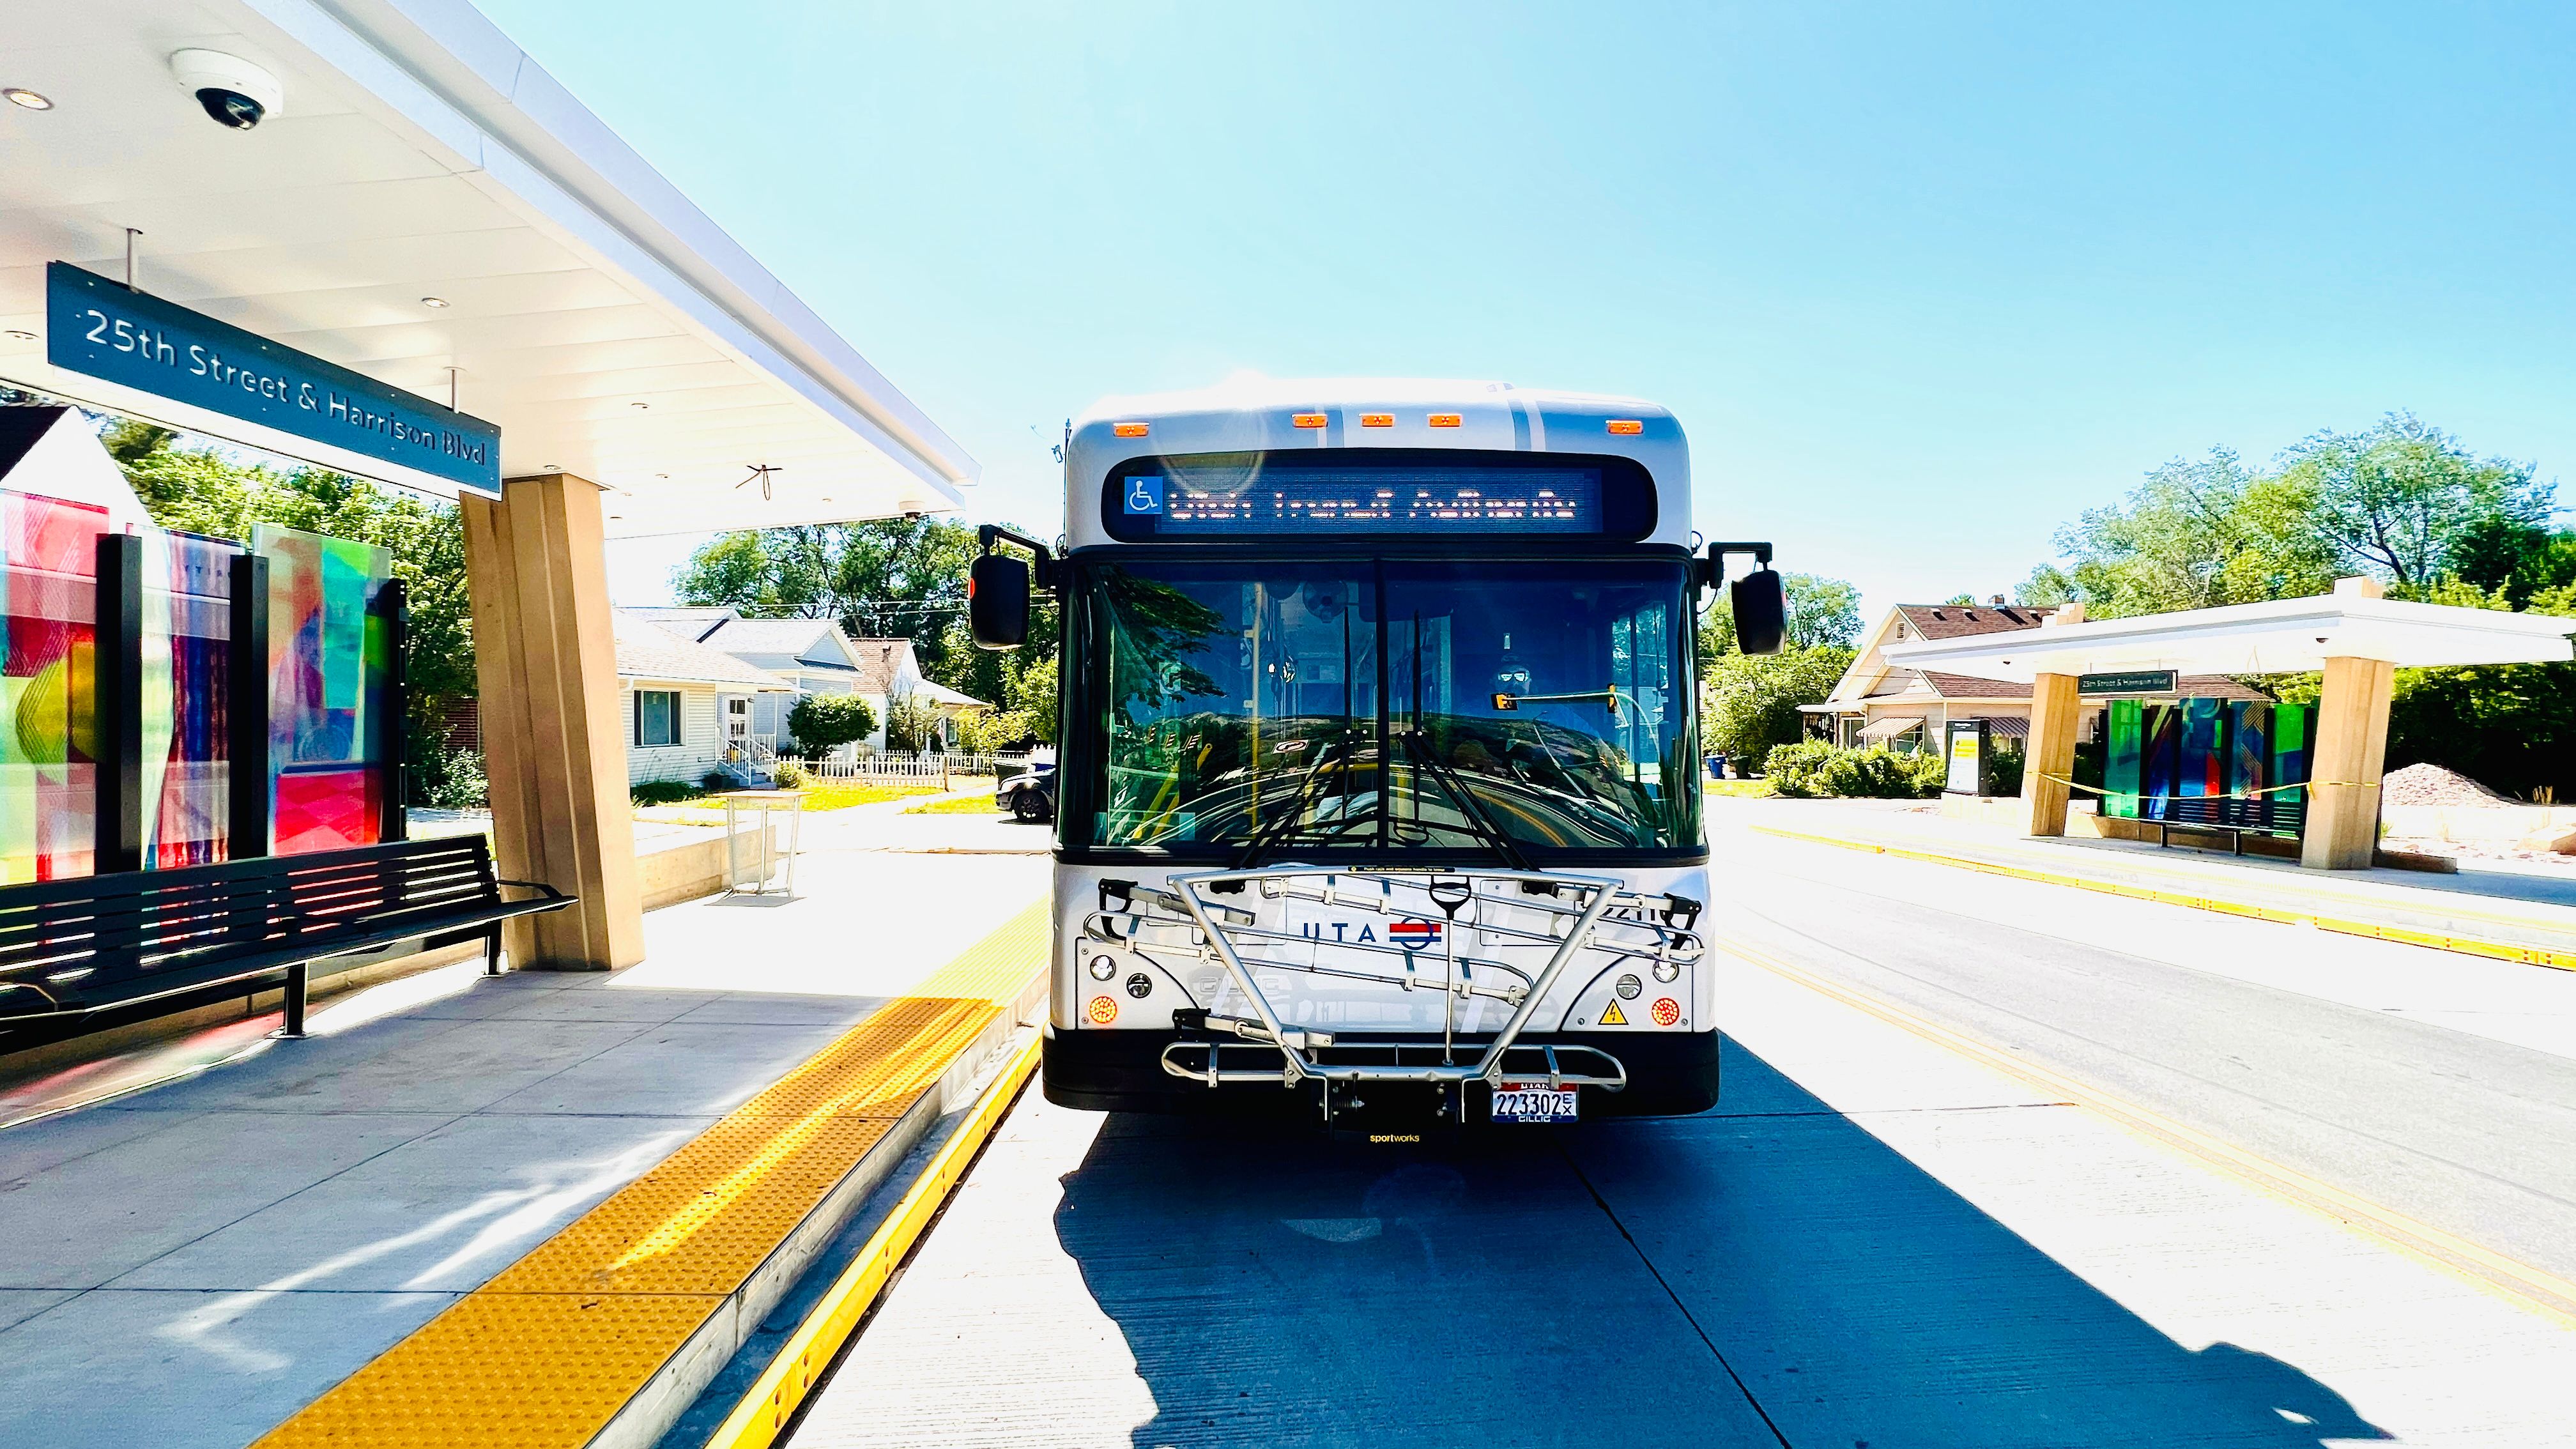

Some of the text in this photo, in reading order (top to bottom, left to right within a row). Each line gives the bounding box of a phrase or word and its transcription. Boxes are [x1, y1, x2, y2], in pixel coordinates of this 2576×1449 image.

[86, 310, 485, 466] 25th Street & Harrison Blvd
[1303, 923, 1376, 942] UTA
[1496, 1093, 1561, 1115] 223302
[1370, 1134, 1420, 1144] sportworks
